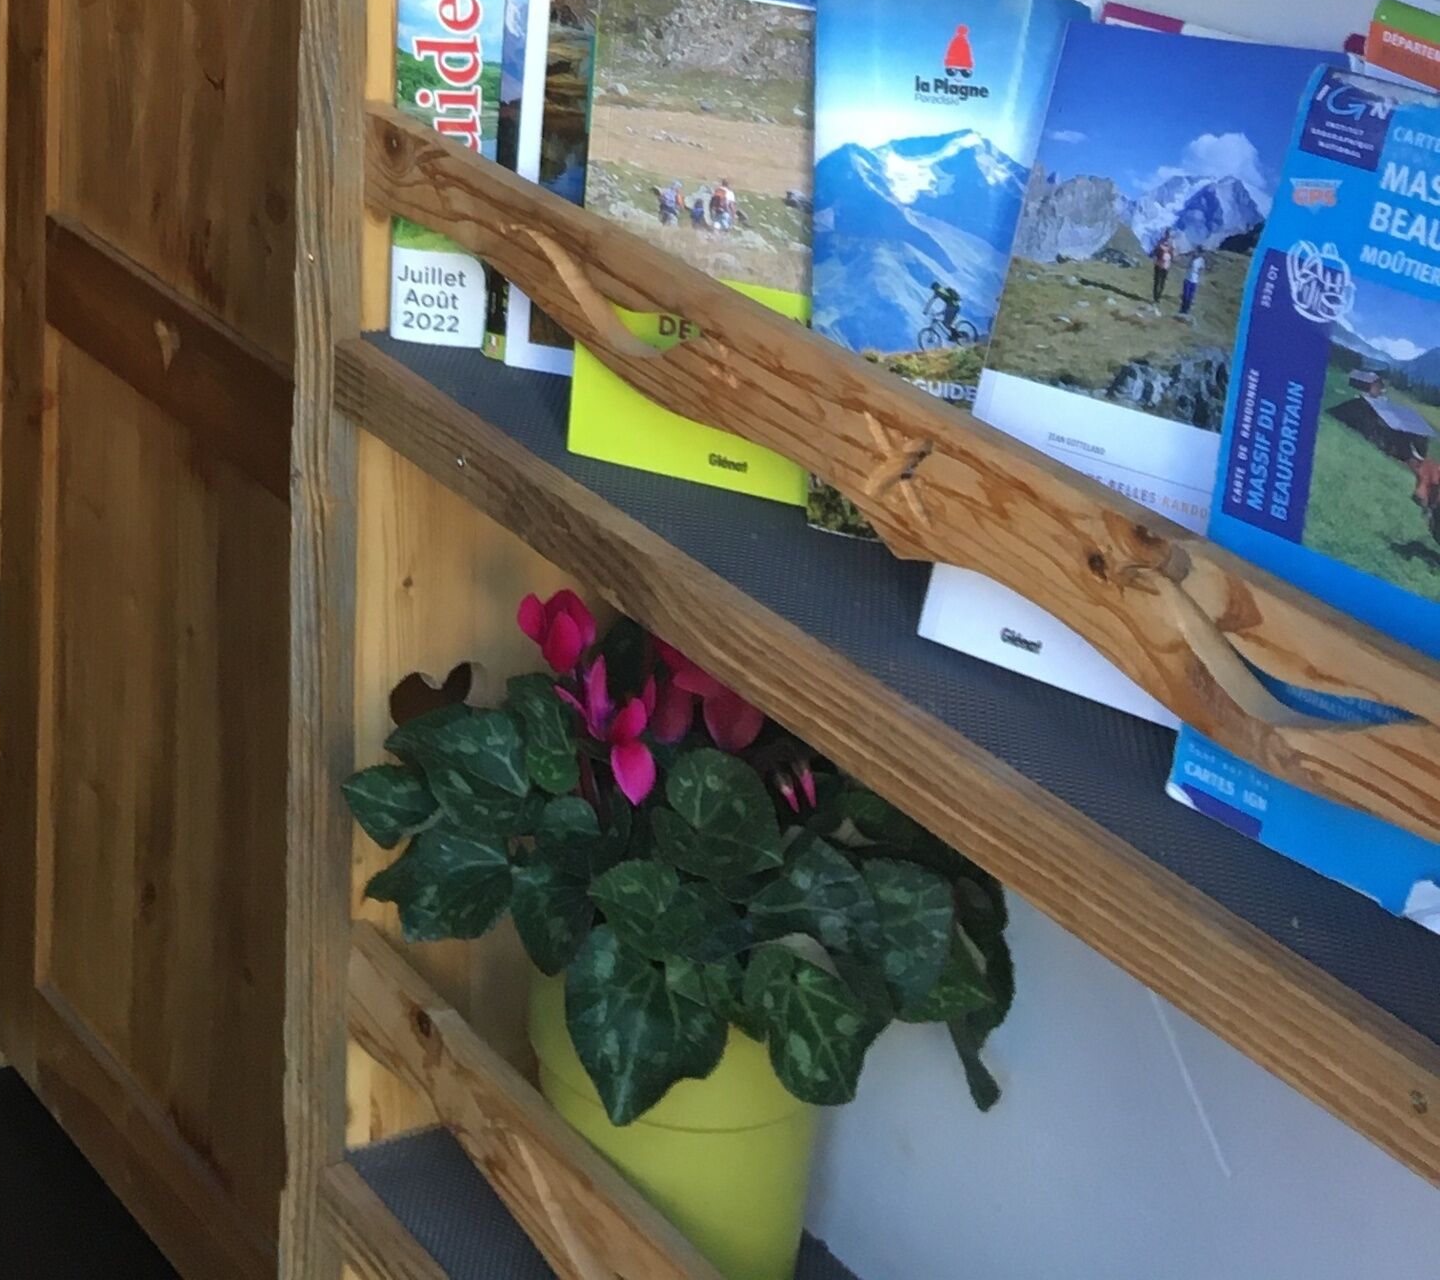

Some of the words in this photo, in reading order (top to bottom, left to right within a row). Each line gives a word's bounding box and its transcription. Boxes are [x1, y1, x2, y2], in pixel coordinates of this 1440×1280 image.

[914, 75, 930, 93] la
[933, 78, 989, 101] Plagne
[397, 265, 466, 288] Juillet
[404, 288, 460, 310] Août
[402, 310, 460, 333] 2022
[1238, 444, 1250, 462] DE
[1246, 431, 1270, 511] MASSIF
[1258, 398, 1278, 431] DU
[1270, 381, 1305, 521] BEAUFORTAIN
[1232, 466, 1246, 504] CARTE
